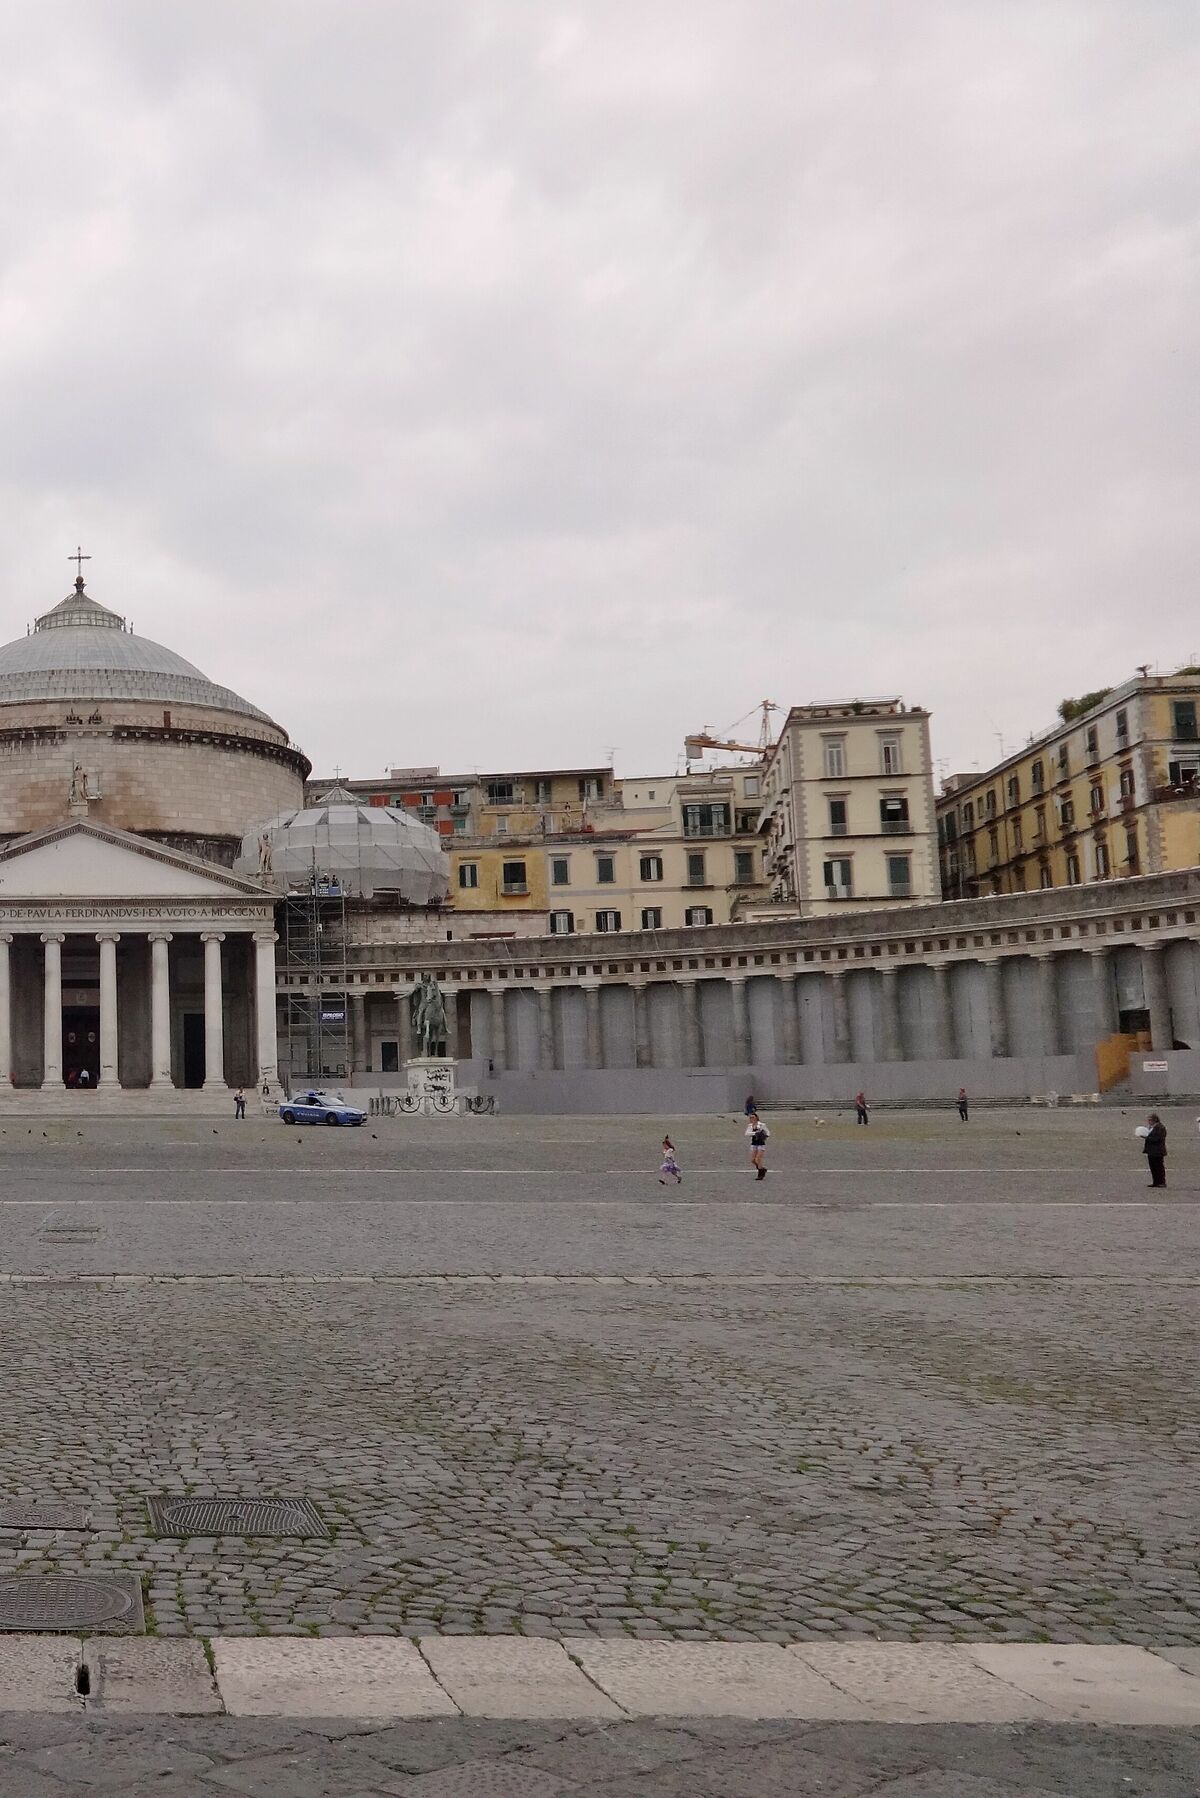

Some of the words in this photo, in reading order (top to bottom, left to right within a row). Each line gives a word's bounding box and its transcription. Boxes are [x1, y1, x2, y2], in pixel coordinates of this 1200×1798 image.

[9, 908, 24, 919] DE
[65, 908, 139, 918] FERDINANDVS
[148, 908, 162, 917] EX
[165, 908, 197, 917] VOTO
[211, 907, 267, 917] MDCCCXVI
